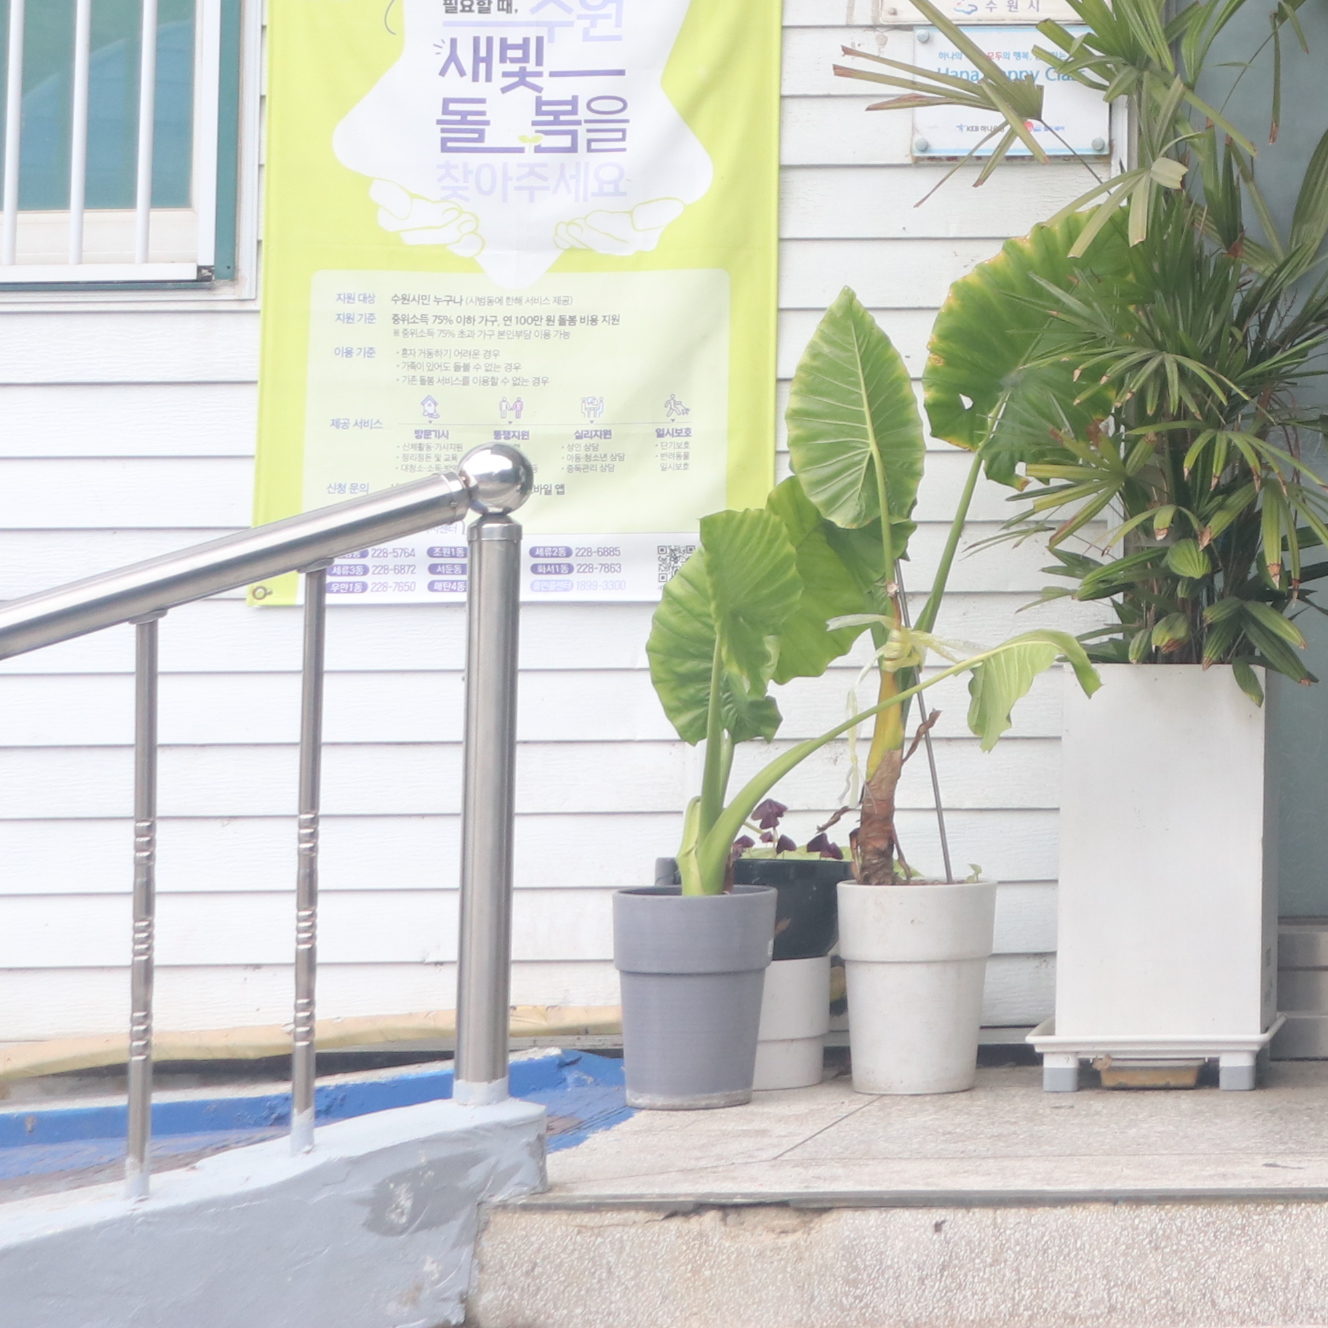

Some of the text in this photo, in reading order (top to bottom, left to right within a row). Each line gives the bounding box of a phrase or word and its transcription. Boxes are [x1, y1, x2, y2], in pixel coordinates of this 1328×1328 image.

[985, 0, 1040, 12] 수원시
[988, 52, 1010, 60] 모두의
[438, 36, 545, 94] 새빛
[436, 94, 630, 154] 돌봄을
[436, 161, 628, 204] 찾아주세요
[336, 292, 375, 304] 지원 대상
[392, 294, 430, 306] 수원시민
[434, 294, 462, 306] 누구나
[525, 296, 550, 306] 서비스
[336, 313, 376, 324] 지원 기준
[392, 314, 429, 325] 중위소득
[432, 315, 453, 324] 75%
[456, 315, 476, 326] 이하
[503, 315, 512, 326] 연
[515, 315, 543, 326] 100만
[558, 315, 577, 326] 돌봄
[580, 315, 599, 326] 비용
[601, 314, 620, 326] 지원
[437, 329, 455, 338] 75%
[334, 346, 376, 358] 이용 기준
[483, 349, 500, 359] 경우
[504, 363, 521, 372] 경우
[532, 376, 549, 386] 경우
[330, 418, 383, 430] 제공 서비스
[655, 428, 692, 438] 일시보호
[371, 548, 415, 558] 228-5764
[434, 548, 465, 556] 조원1동
[575, 547, 621, 557] 228-6885
[372, 565, 416, 575] 228-6872
[577, 564, 622, 573] 228-7863
[331, 582, 415, 592] 우만1동 228-7650
[577, 580, 626, 590] 1899-3300
